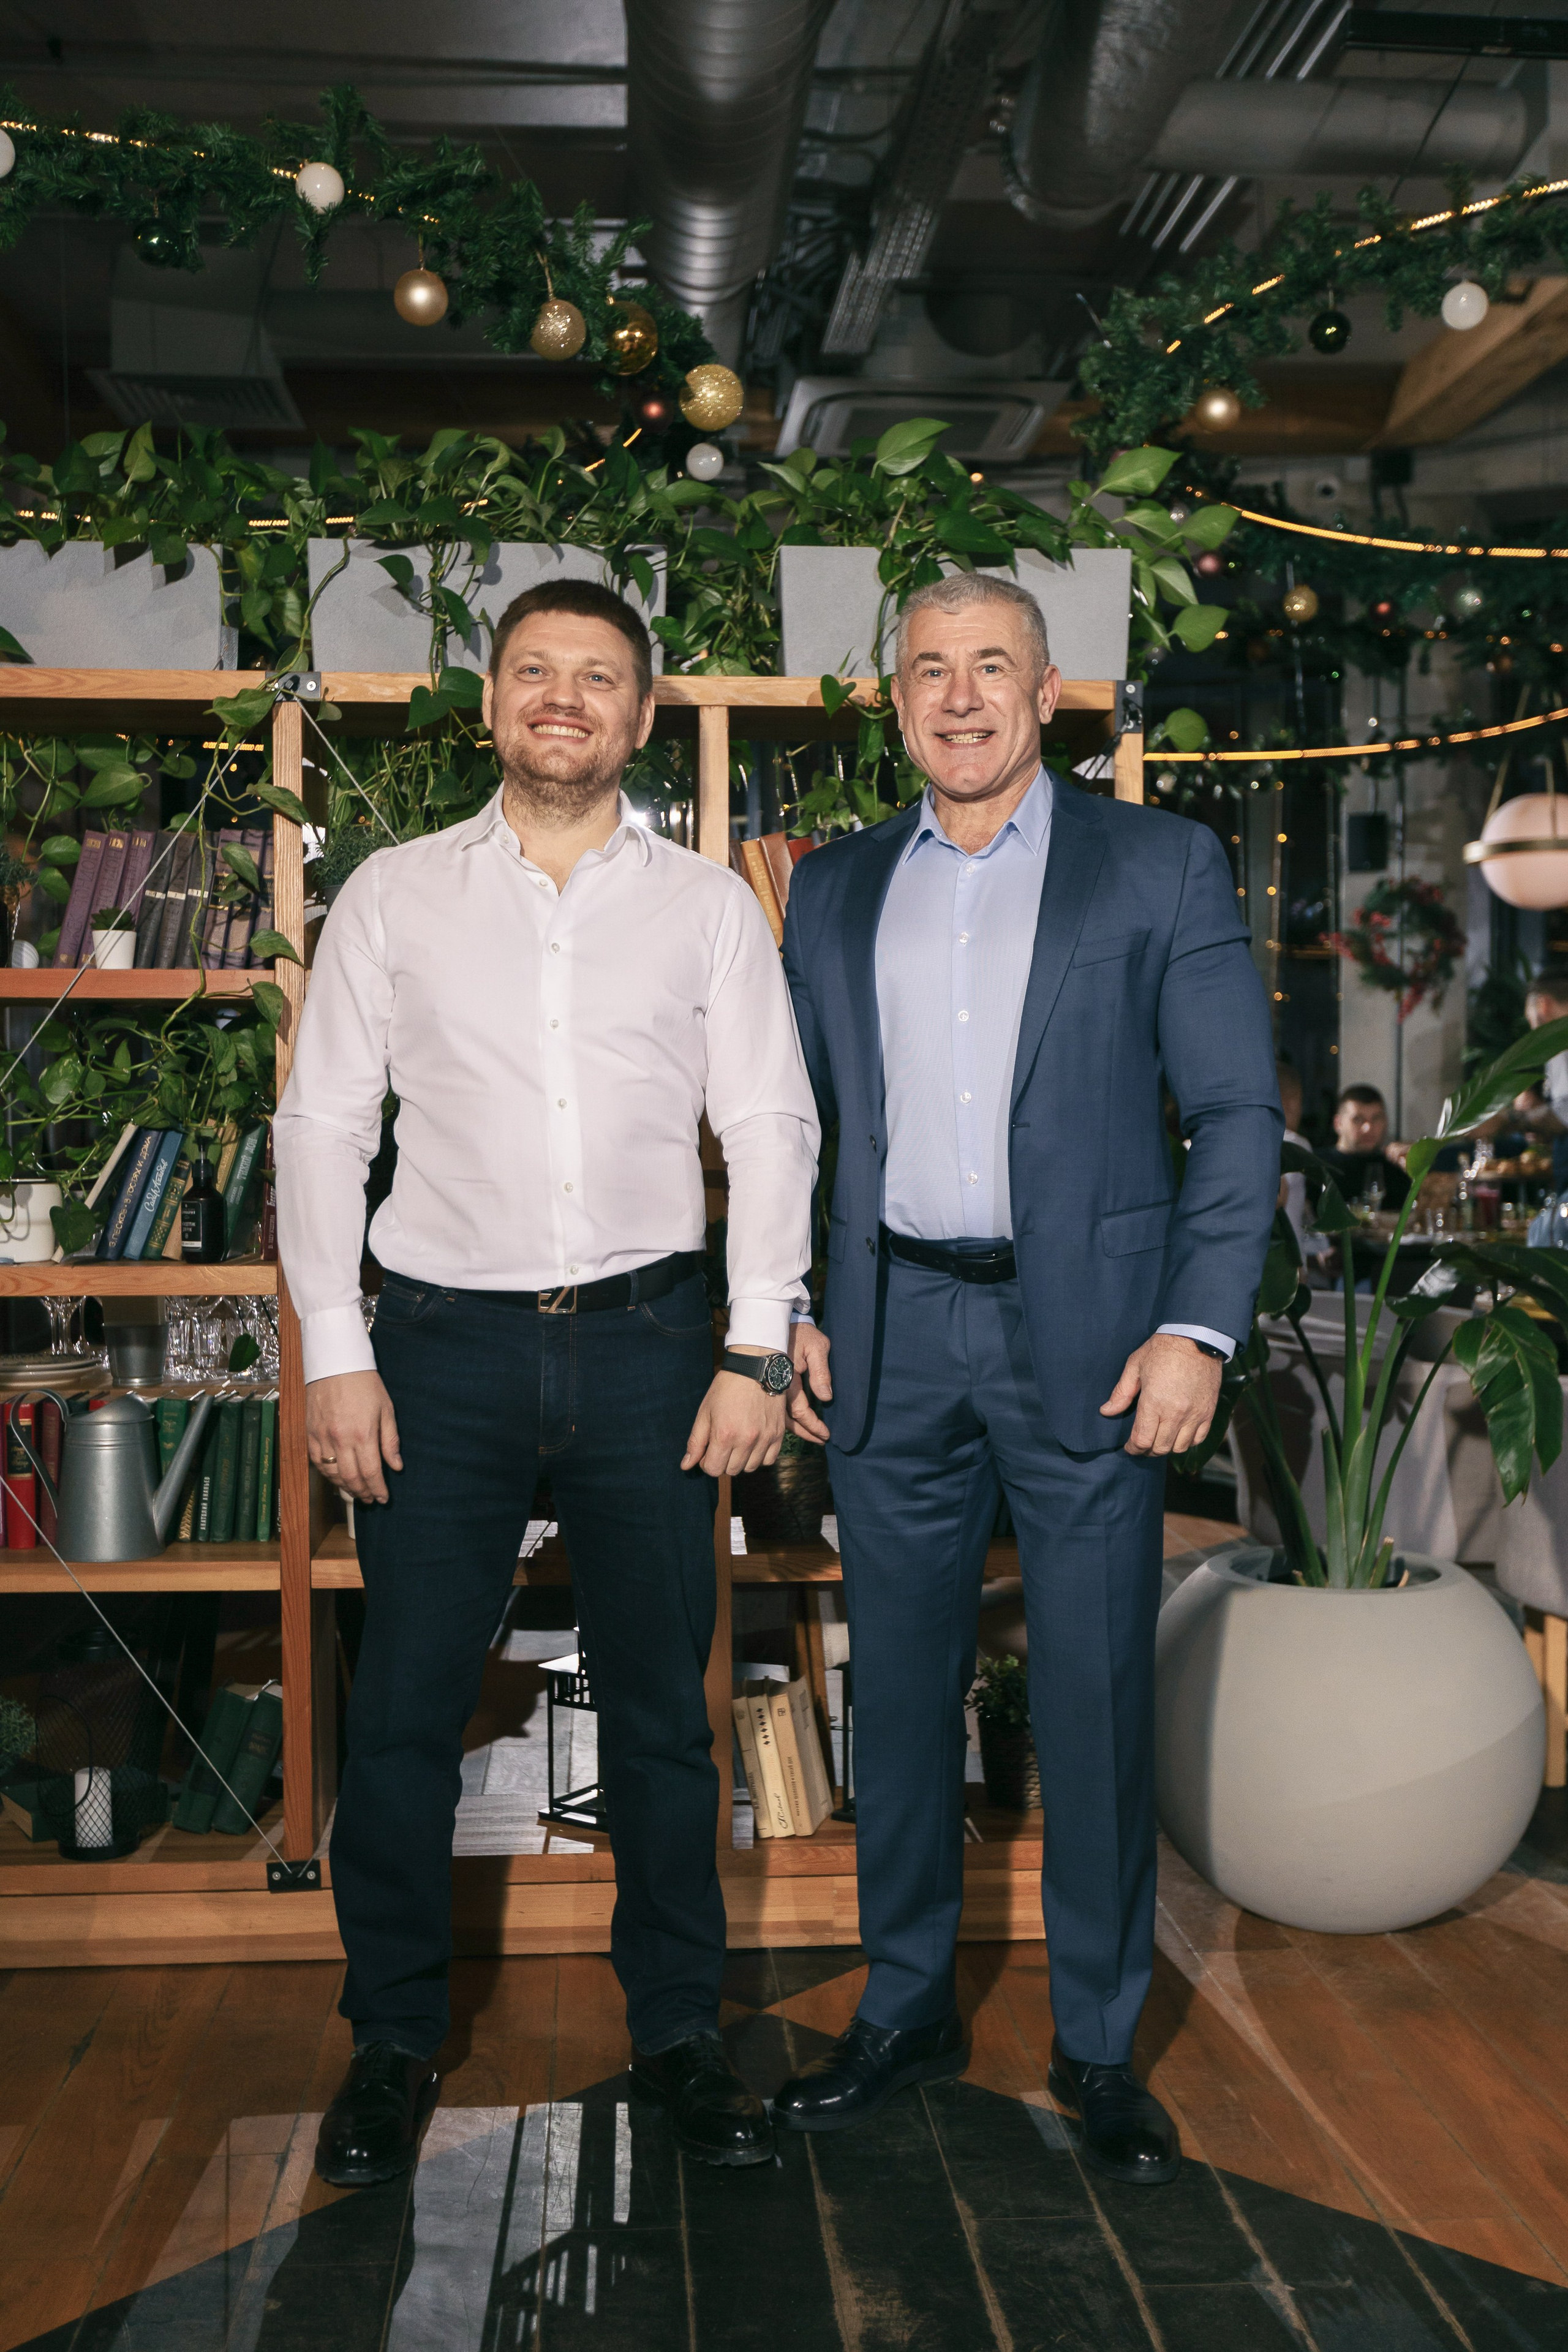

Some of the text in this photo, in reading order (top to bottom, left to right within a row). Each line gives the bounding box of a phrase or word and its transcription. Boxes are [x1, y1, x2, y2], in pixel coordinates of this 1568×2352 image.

[127, 1167, 141, 1196] ГОСТЯХ
[140, 1136, 152, 1159] ДОМА
[236, 1137, 258, 1180] ТИХИЙ ДОН
[144, 1186, 160, 1212] Сабир
